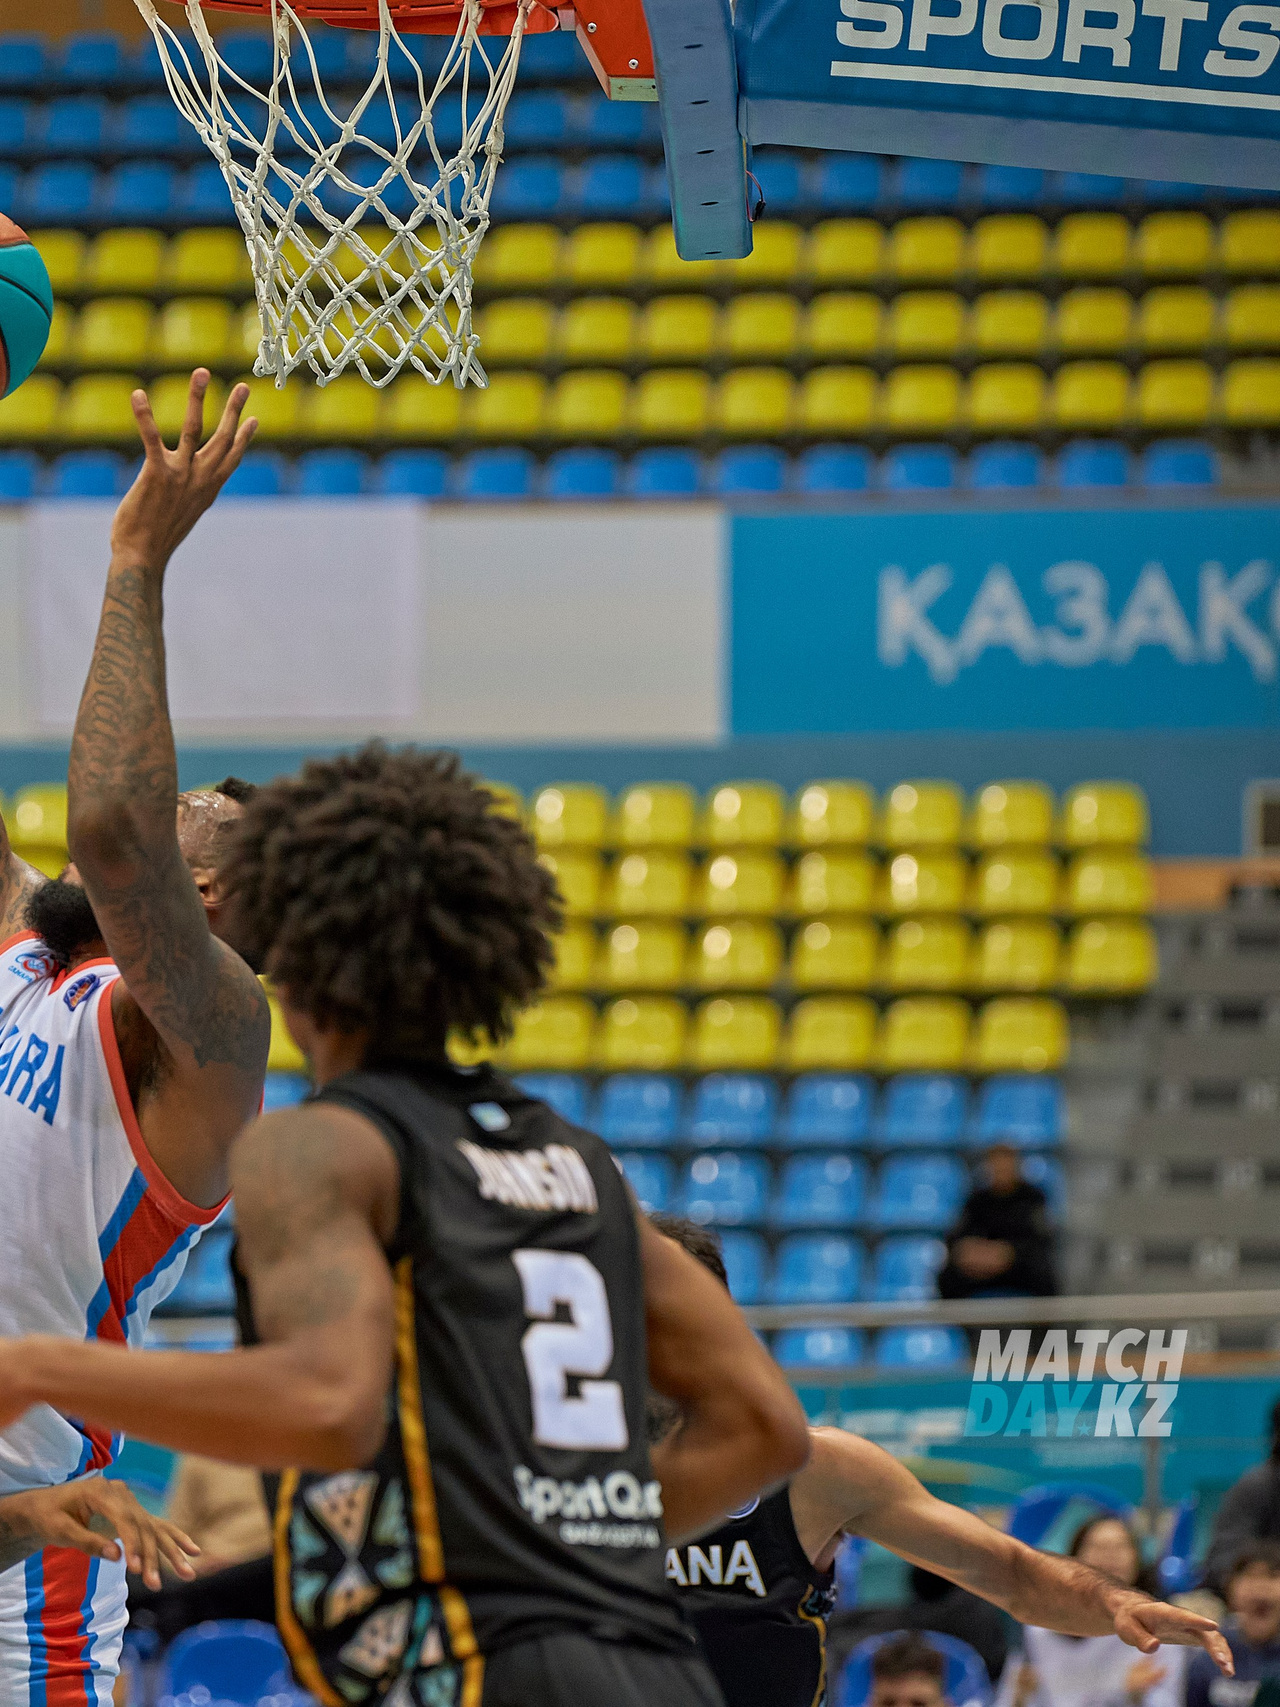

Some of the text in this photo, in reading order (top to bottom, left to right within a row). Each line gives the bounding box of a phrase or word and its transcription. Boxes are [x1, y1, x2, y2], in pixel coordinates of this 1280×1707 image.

[835, 0, 1280, 79] SPORTS
[877, 560, 1280, 686] ҚАЗАҚ
[511, 1247, 630, 1452] 2
